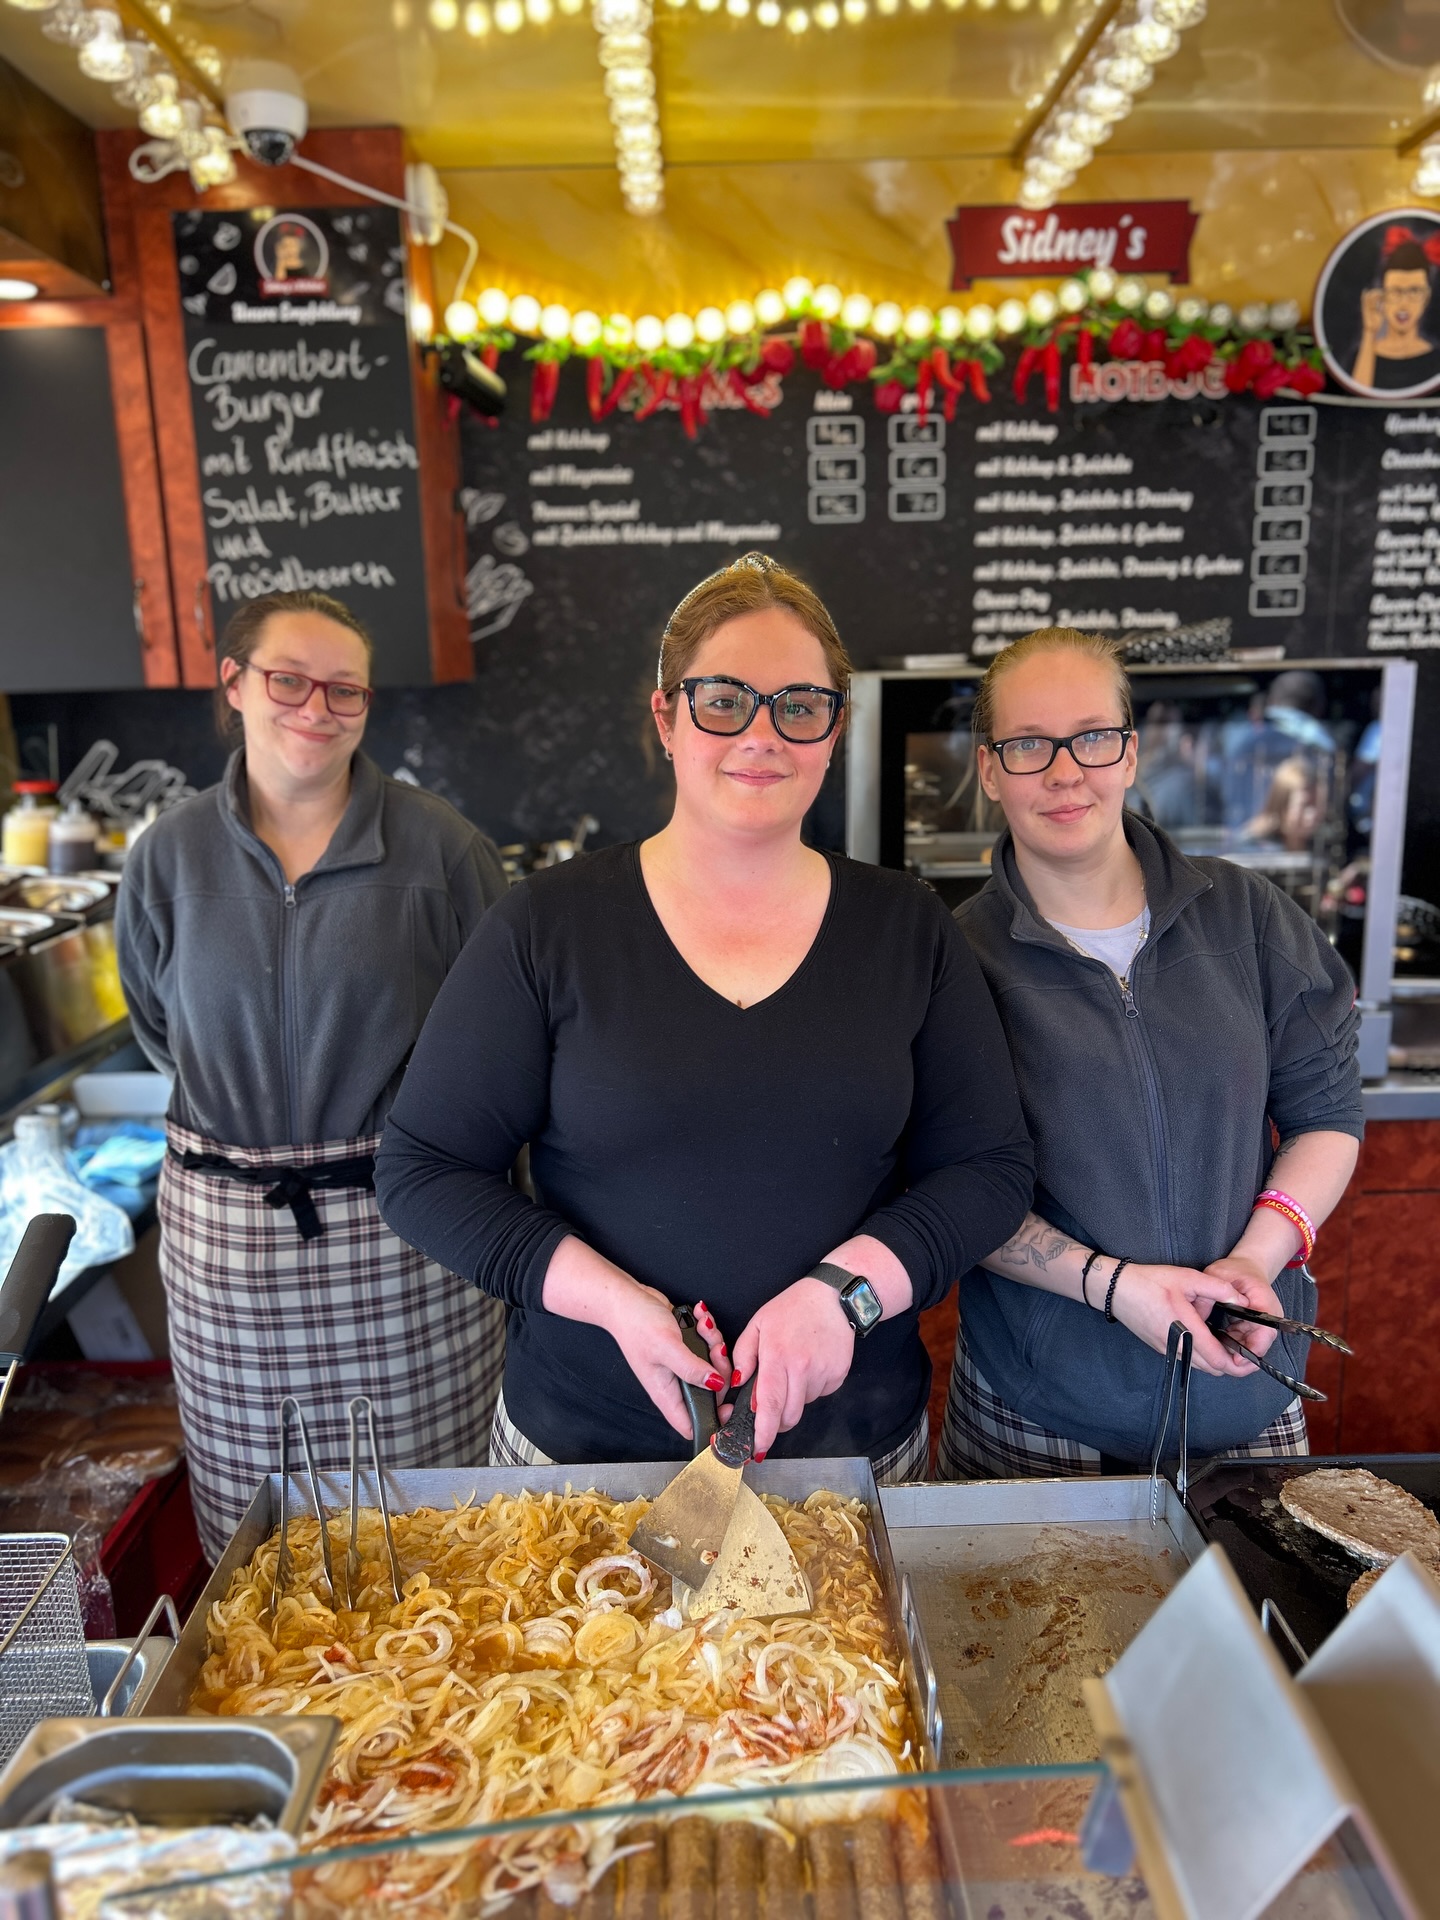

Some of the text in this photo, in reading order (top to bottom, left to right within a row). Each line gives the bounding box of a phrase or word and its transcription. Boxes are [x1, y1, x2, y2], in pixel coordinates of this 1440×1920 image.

[279, 300, 362, 326] Empfehlung
[204, 384, 324, 441] Burger
[527, 429, 611, 453] mit Ketchup
[975, 420, 1058, 444] mit Ketchup
[529, 465, 555, 486] mit
[974, 453, 1134, 480] mit Ketchup & Zwiebeln
[974, 491, 1001, 513] mit
[1060, 488, 1121, 512] Zwiebeln
[1122, 488, 1134, 509] &
[1135, 486, 1194, 512] Dressing
[1378, 485, 1402, 503] mit
[212, 525, 273, 561] und
[532, 525, 558, 546] mit
[559, 523, 620, 547] Zwiebeln
[621, 522, 674, 547] Ketchup
[675, 521, 704, 543] und
[973, 526, 1000, 548] mit
[1059, 524, 1120, 547] Zwiebeln
[1120, 524, 1133, 545] &
[1133, 522, 1184, 547] Gurken
[973, 561, 1000, 582] mit
[1123, 556, 1179, 581] Dressing
[1180, 556, 1192, 577] &
[1193, 554, 1244, 579] Gurken
[971, 612, 999, 633] mit
